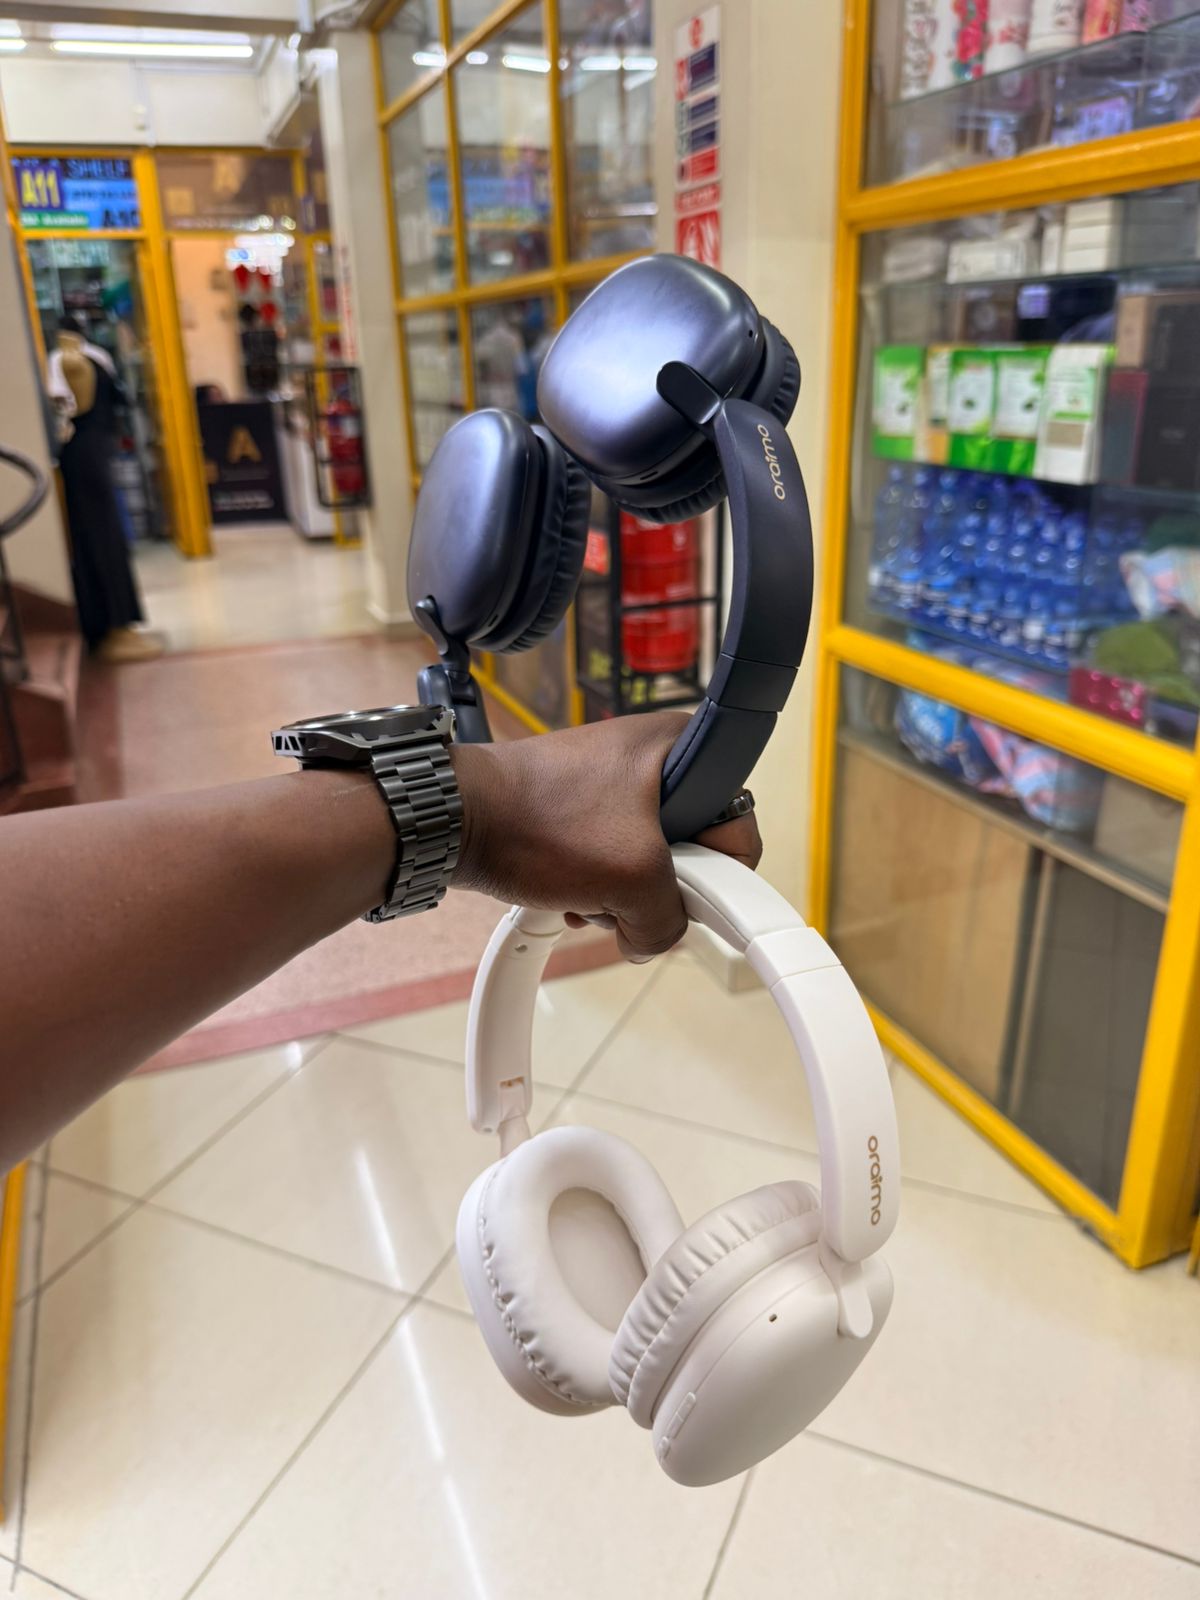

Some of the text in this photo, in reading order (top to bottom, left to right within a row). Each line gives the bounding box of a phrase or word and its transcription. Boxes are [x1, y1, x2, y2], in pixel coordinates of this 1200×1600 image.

[21, 169, 61, 208] A11
[757, 424, 786, 500] oraimo
[867, 1135, 883, 1226] oraimo
